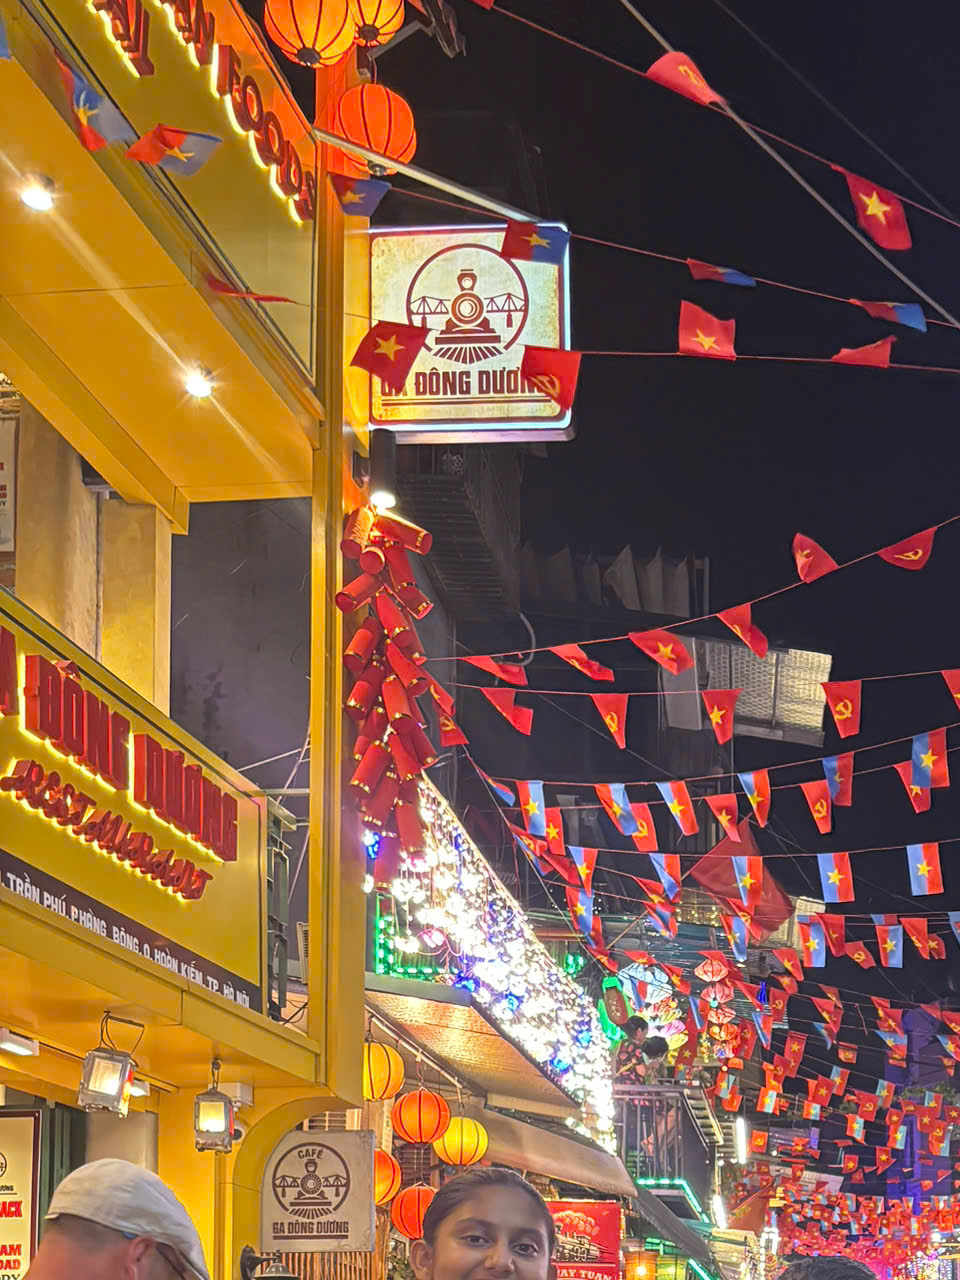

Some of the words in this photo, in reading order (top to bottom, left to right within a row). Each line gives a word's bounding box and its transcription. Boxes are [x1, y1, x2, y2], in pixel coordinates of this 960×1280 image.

[415, 367, 471, 396] ĐÔNG
[478, 366, 545, 395] DƯƠ
[272, 1221, 285, 1235] GA
